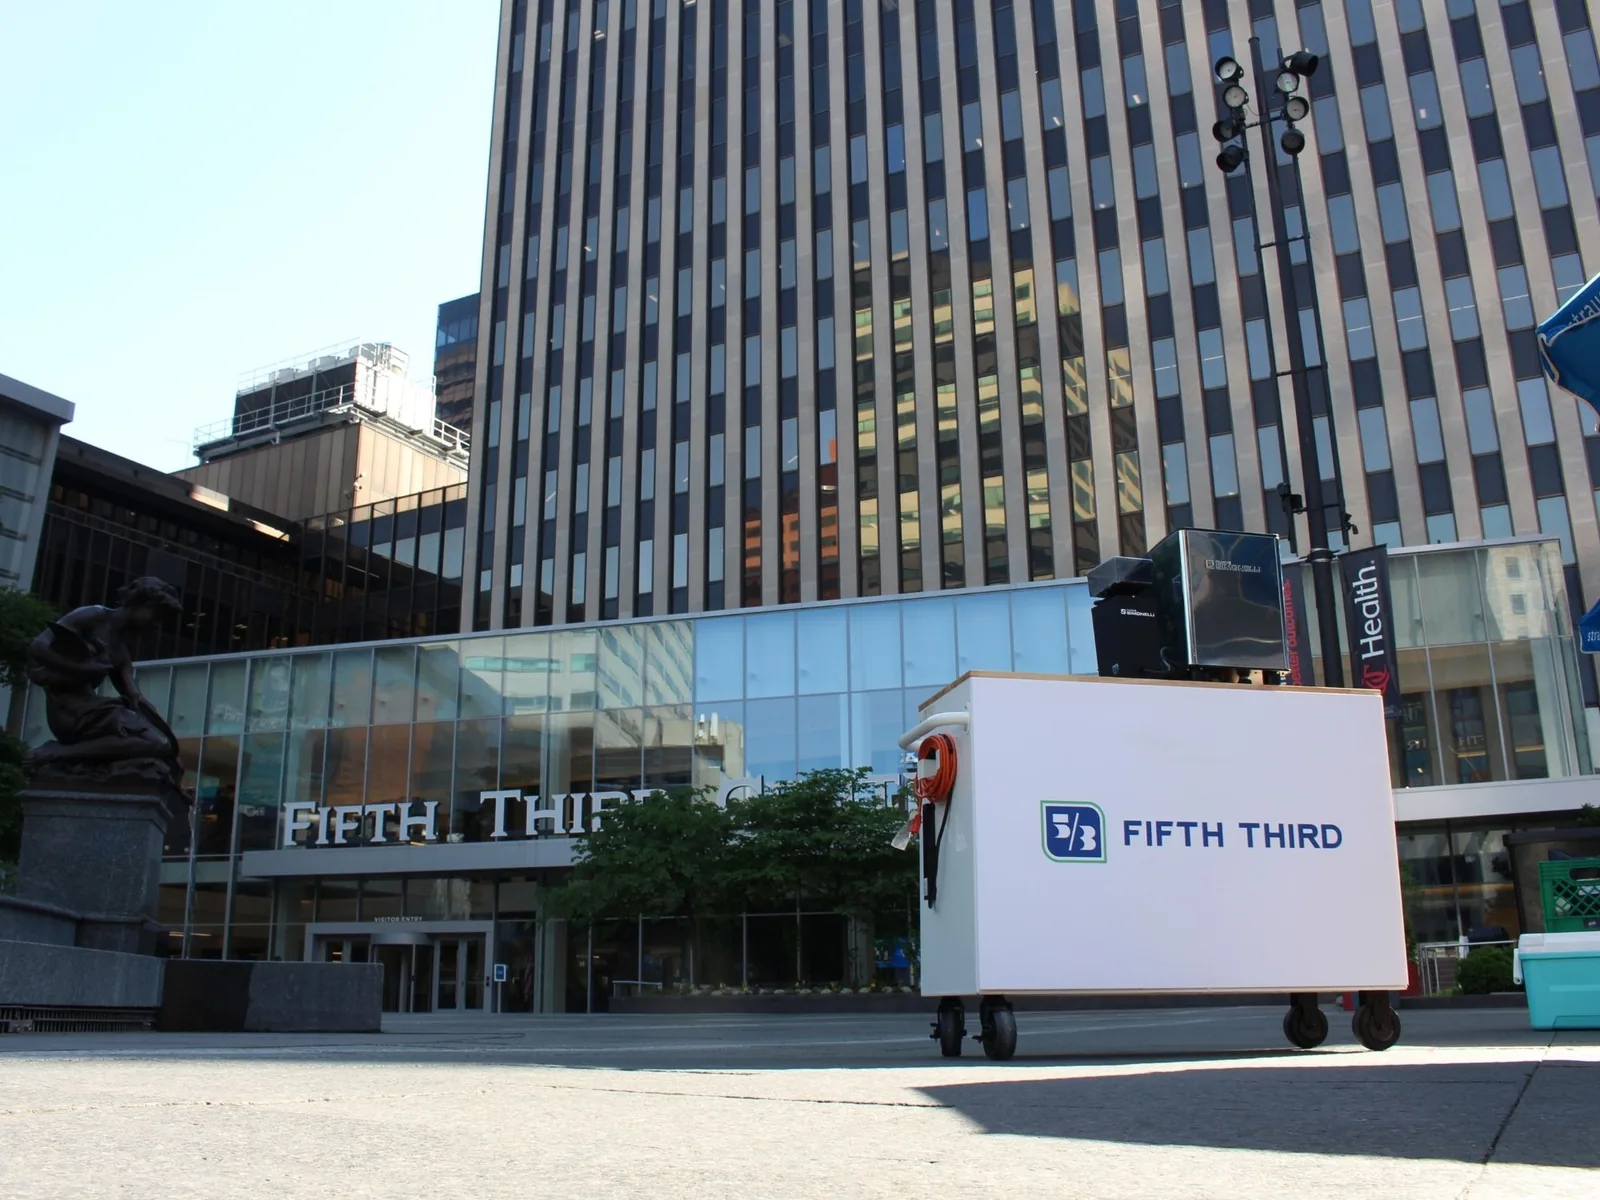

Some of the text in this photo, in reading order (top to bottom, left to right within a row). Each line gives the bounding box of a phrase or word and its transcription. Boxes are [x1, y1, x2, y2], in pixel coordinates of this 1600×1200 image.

[283, 801, 439, 846] FIFTH
[1123, 820, 1343, 849] FIFTH THIRD
